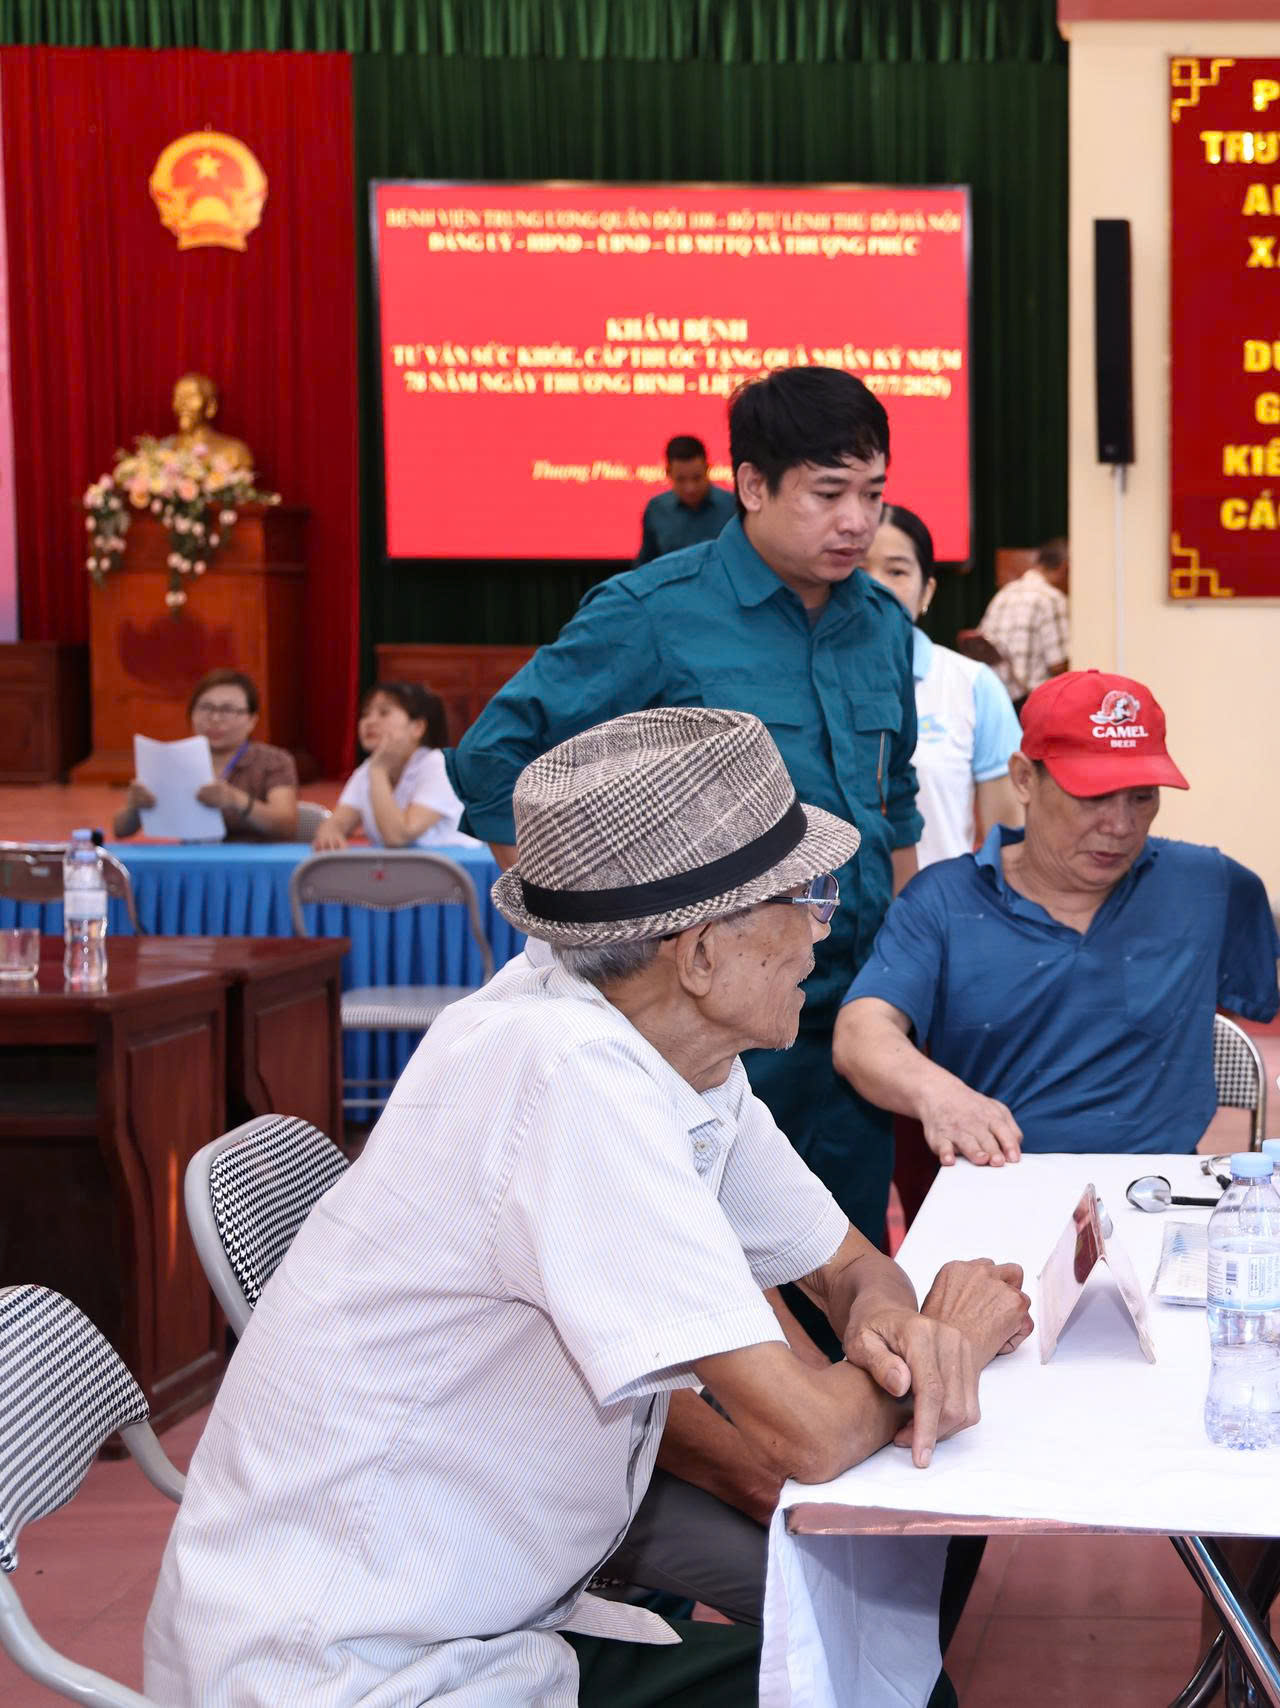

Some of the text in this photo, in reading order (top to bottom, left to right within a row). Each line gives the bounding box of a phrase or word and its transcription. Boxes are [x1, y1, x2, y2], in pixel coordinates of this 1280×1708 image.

[606, 312, 680, 342] KHÁM
[1091, 725, 1149, 738] CAMEL
[1110, 739, 1137, 748] BEER
